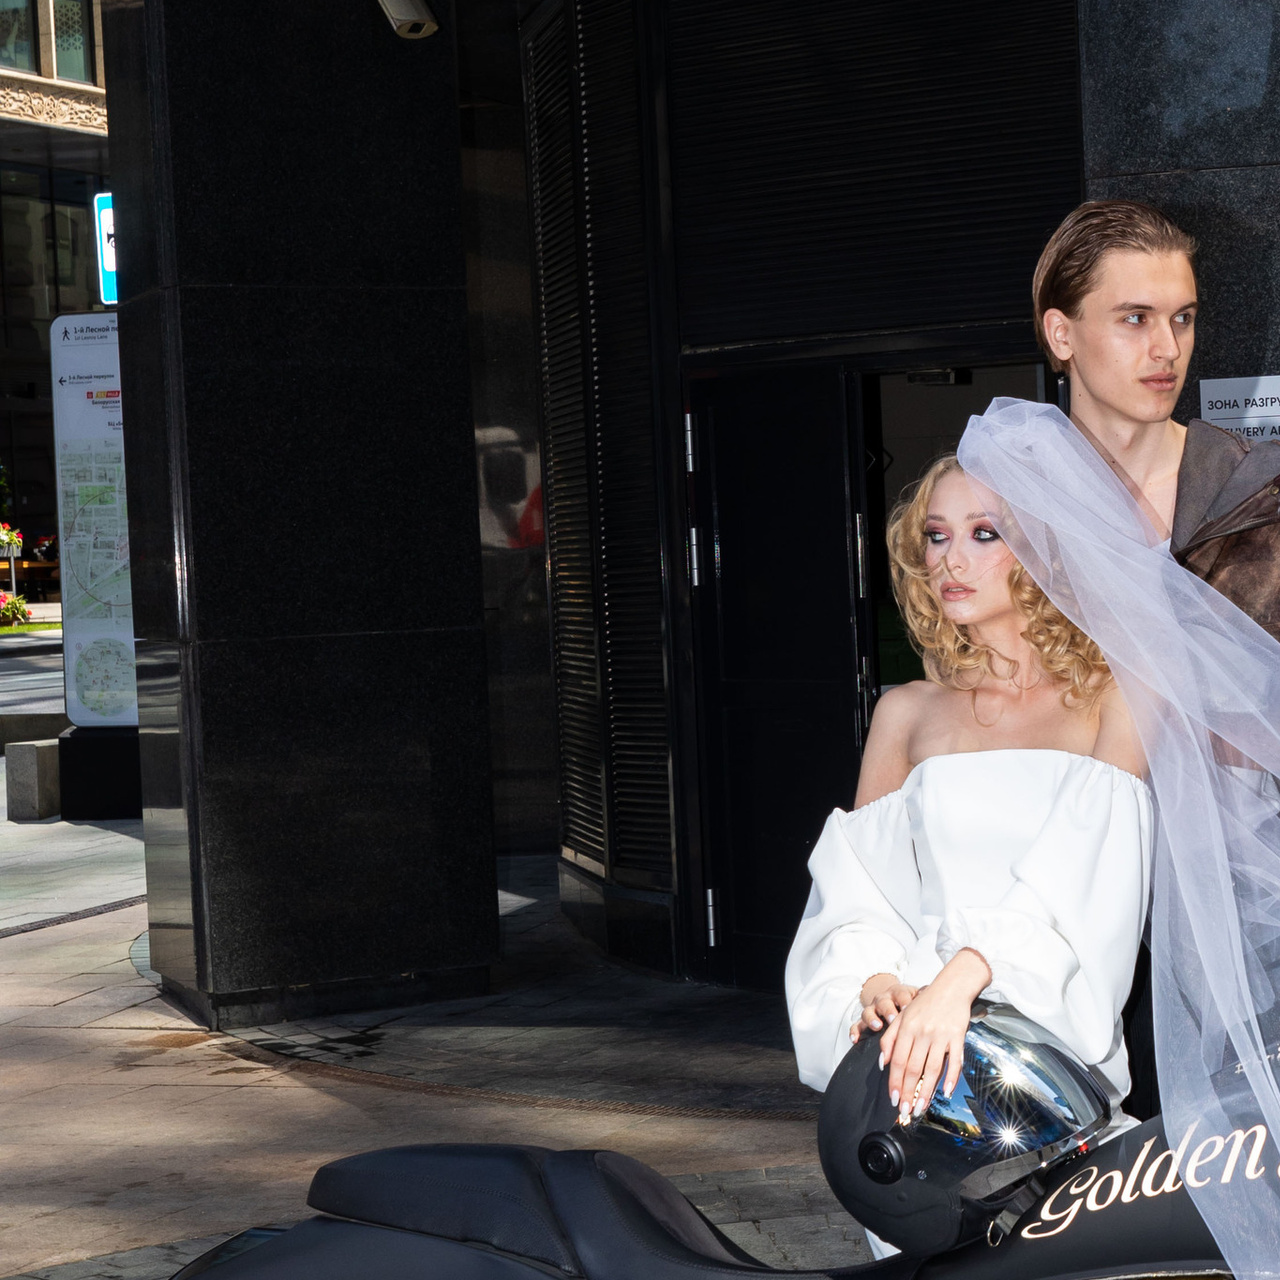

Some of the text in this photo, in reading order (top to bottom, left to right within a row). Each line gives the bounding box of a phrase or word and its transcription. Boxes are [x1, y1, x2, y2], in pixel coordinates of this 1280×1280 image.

[85, 325, 110, 333] Лесной
[1207, 399, 1240, 411] ЗОНА
[1020, 1120, 1268, 1240] Golden
